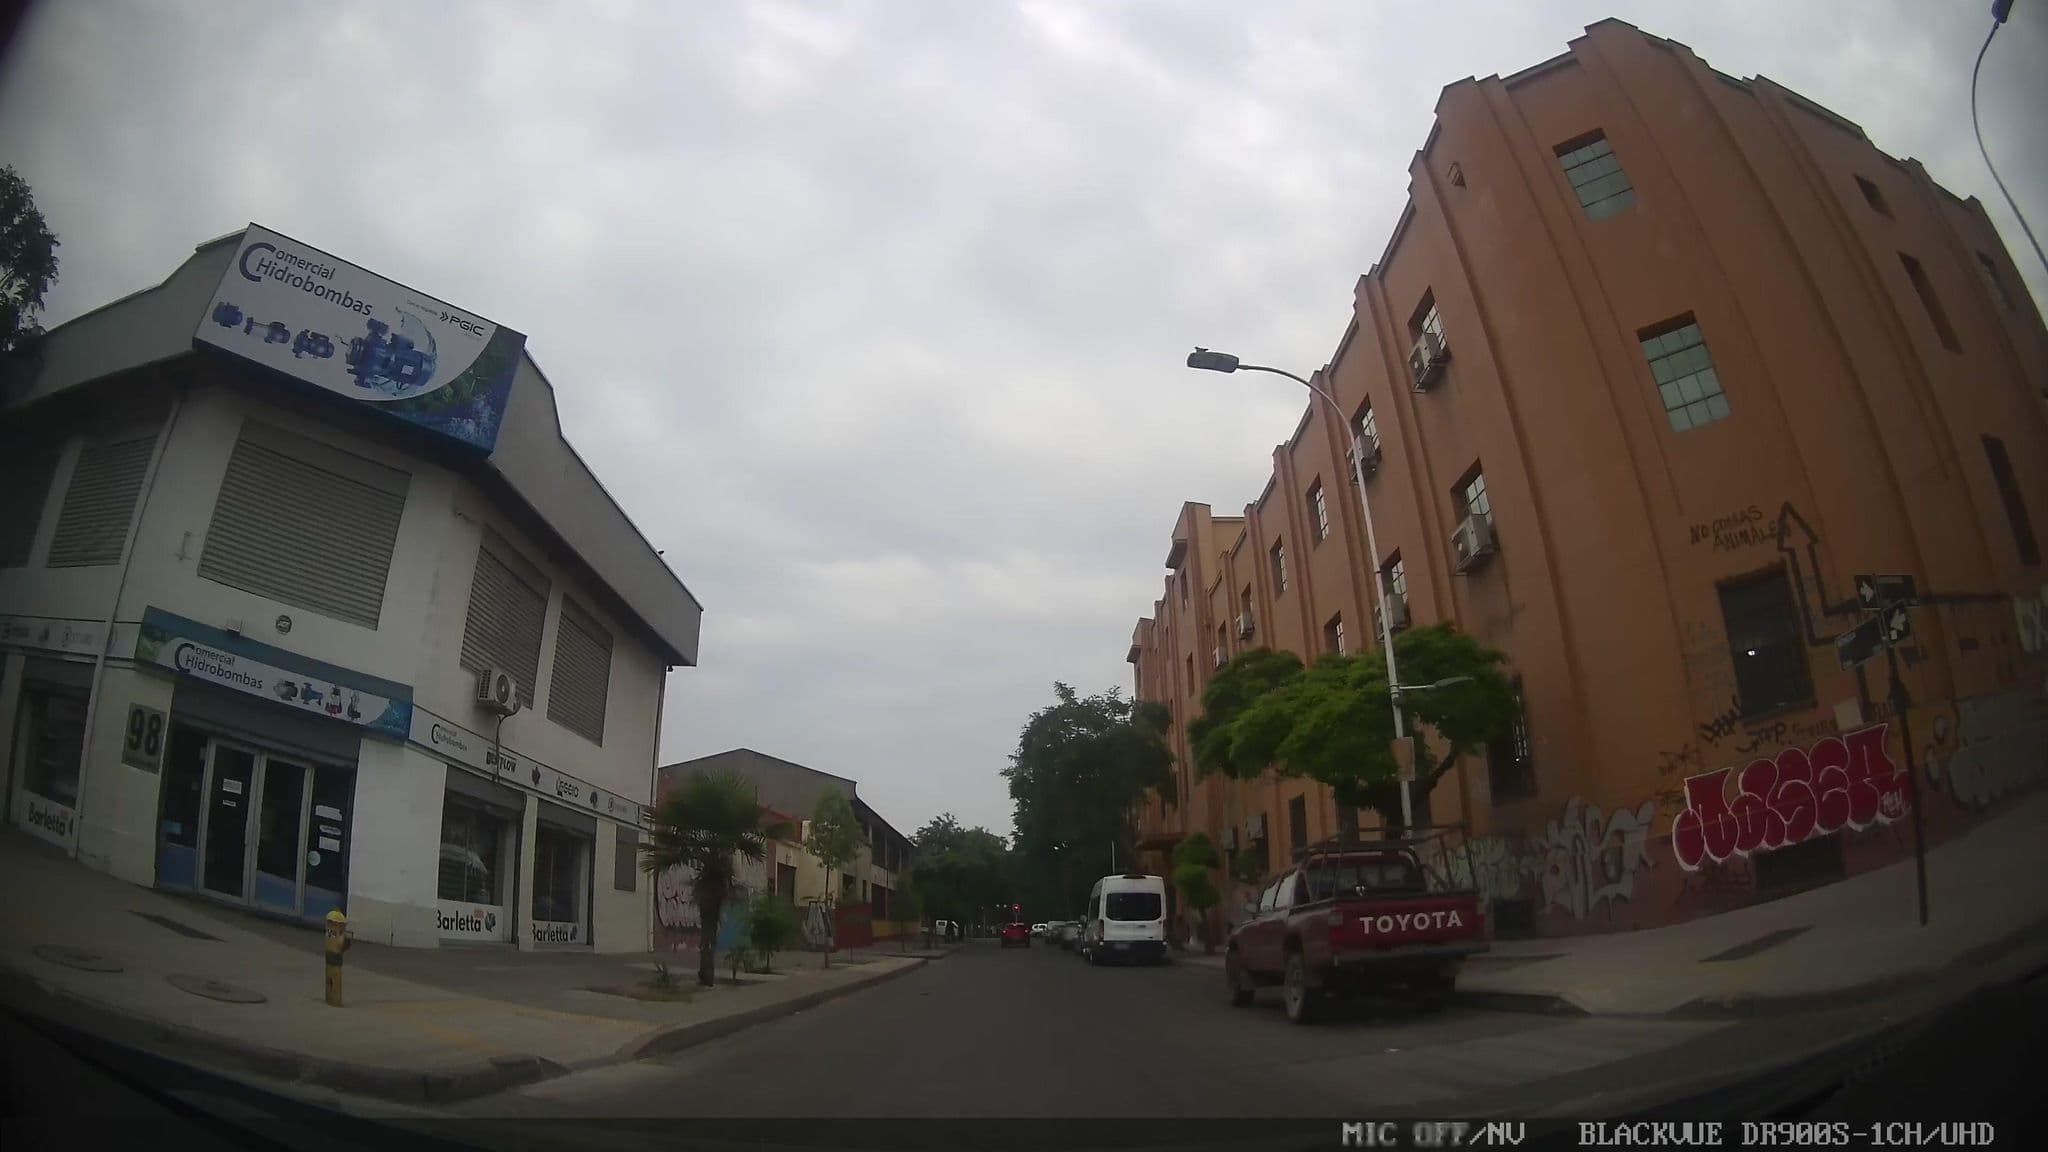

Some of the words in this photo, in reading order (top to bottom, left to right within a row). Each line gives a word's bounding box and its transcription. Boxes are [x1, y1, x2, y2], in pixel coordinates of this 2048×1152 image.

[239, 242, 336, 282] Comercial
[256, 257, 374, 317] Hidrobombas
[449, 315, 485, 337] PGIC
[175, 643, 235, 673] Comercial
[185, 654, 264, 689] Hidrobombas
[127, 708, 162, 757] 98
[1359, 910, 1464, 935] TOYOTA
